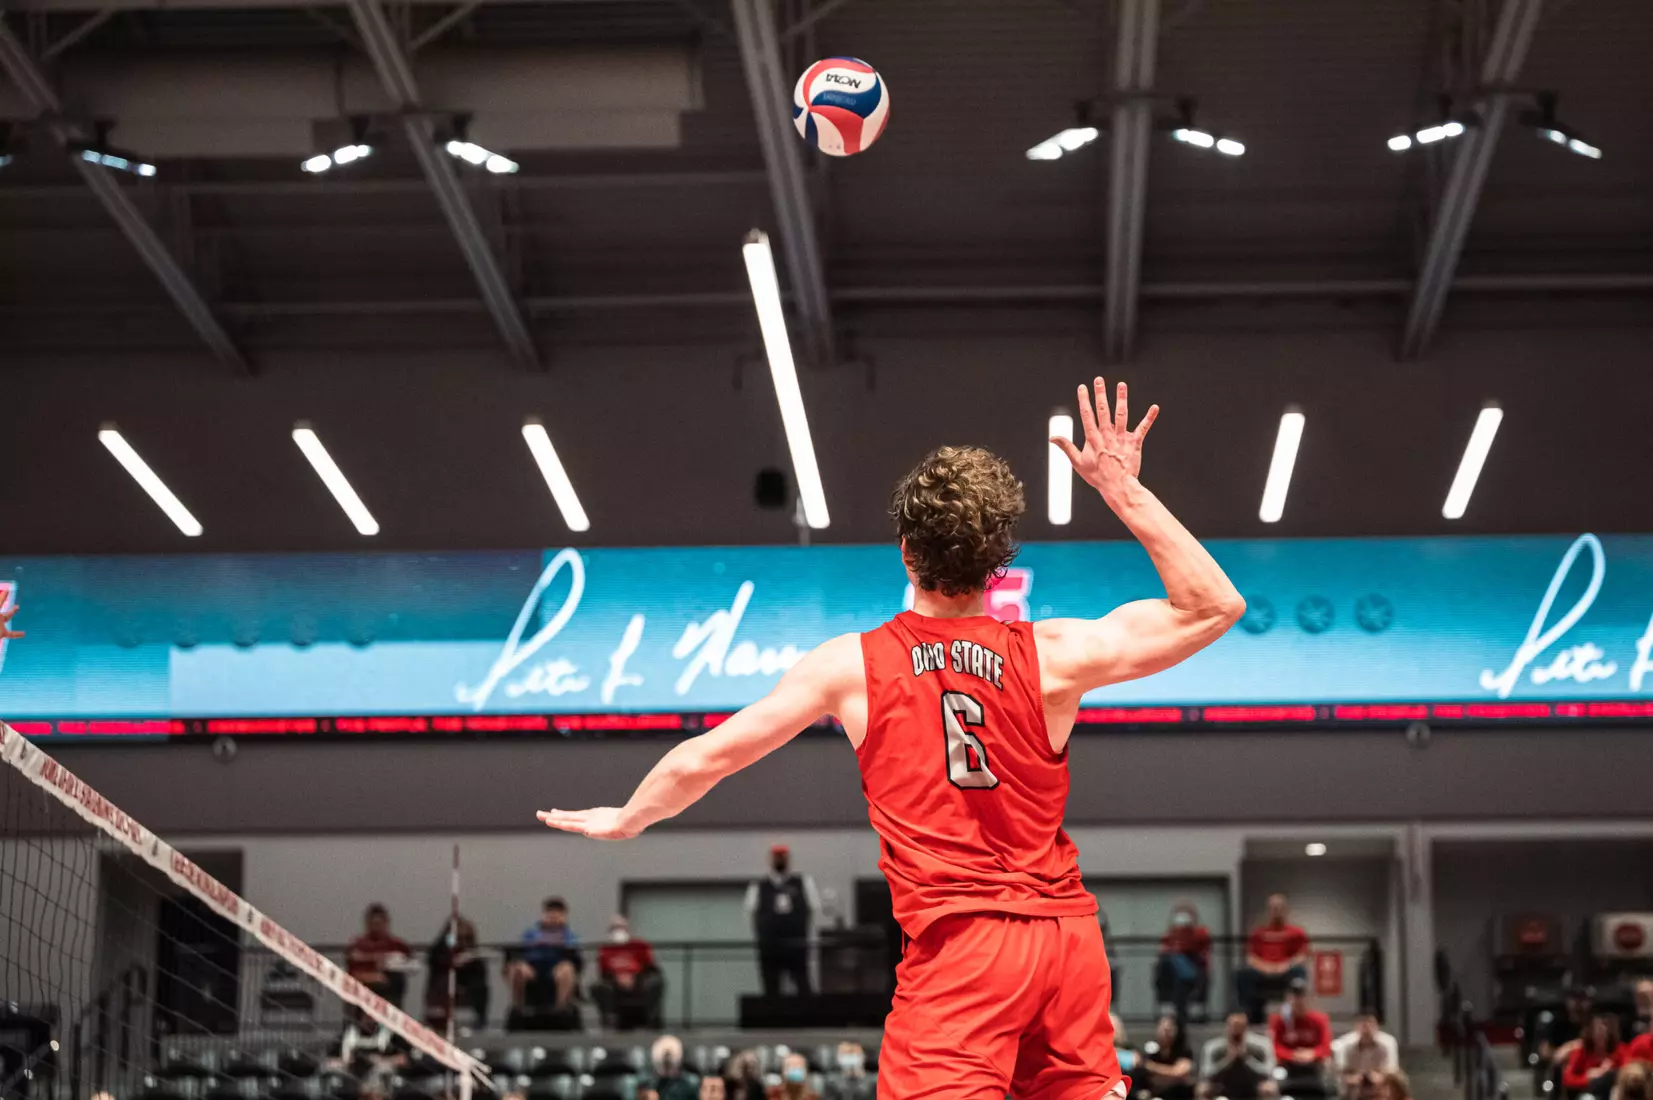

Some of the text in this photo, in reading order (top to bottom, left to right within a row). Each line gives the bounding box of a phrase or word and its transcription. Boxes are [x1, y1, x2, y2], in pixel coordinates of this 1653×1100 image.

[826, 73, 861, 89] NCAA
[950, 639, 1004, 691] STATE
[941, 690, 1000, 790] 6
